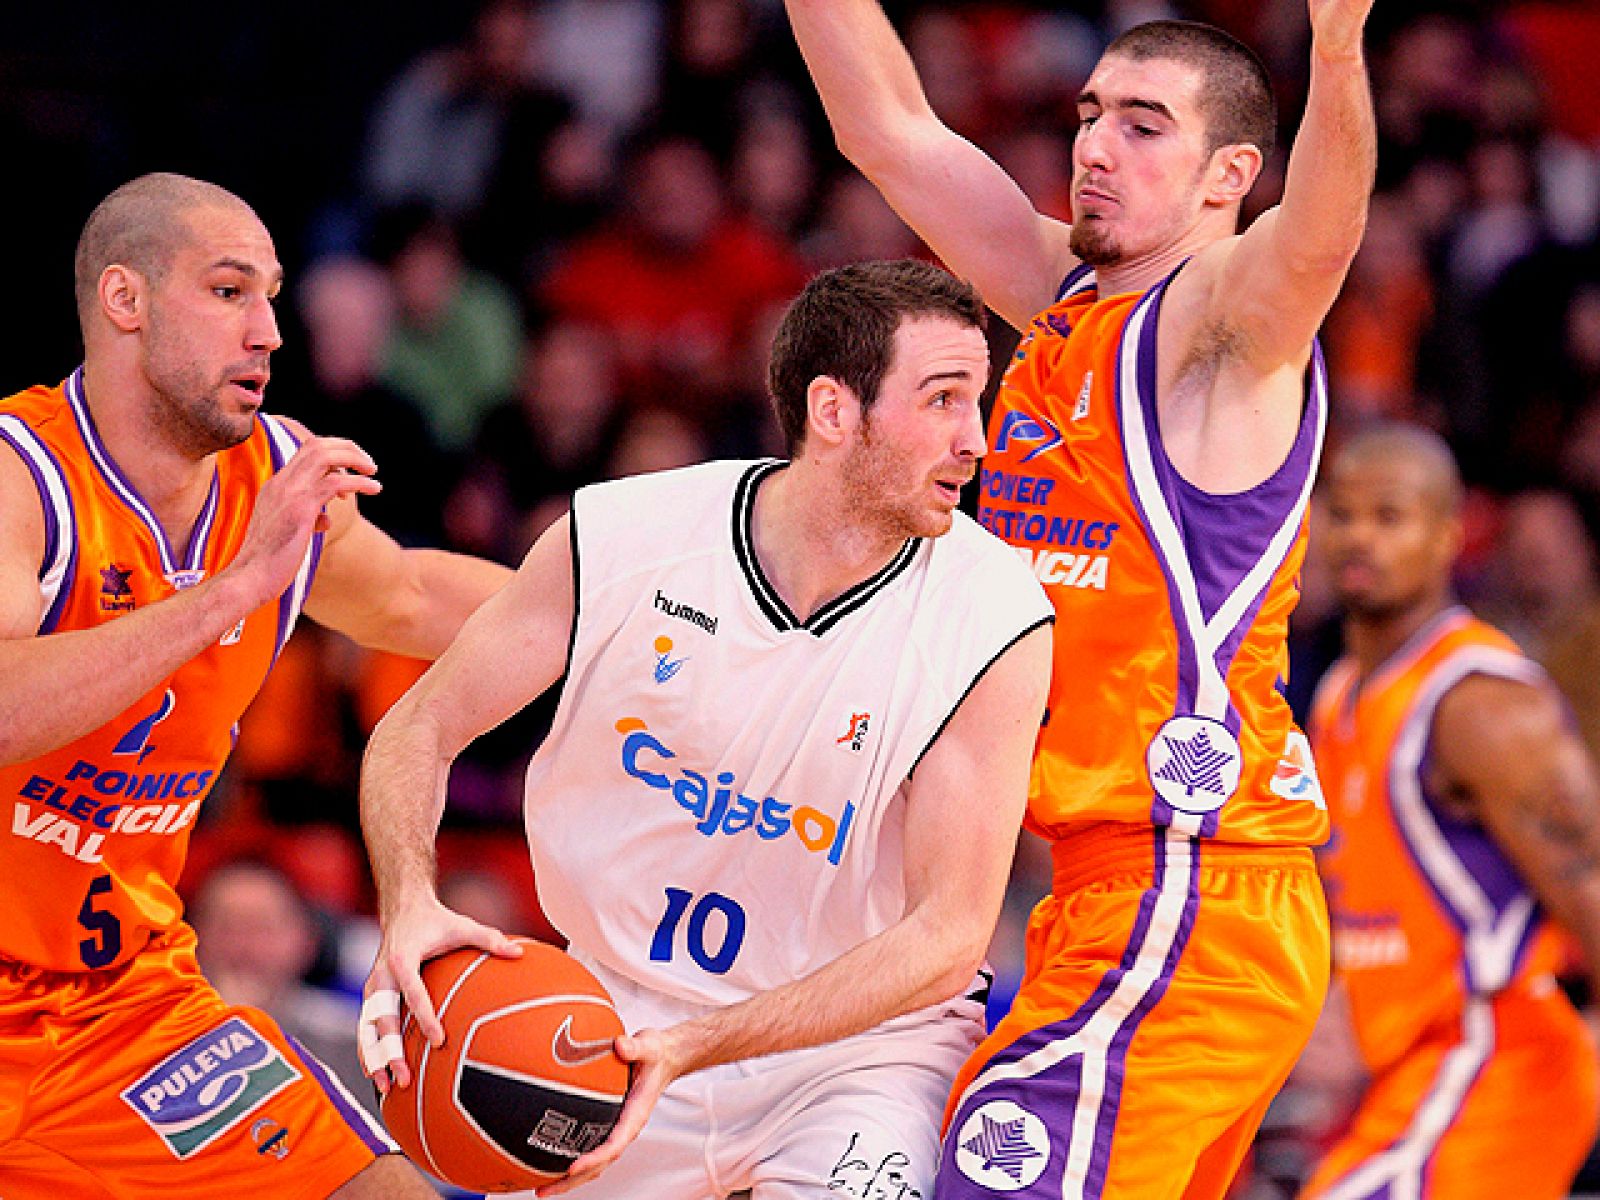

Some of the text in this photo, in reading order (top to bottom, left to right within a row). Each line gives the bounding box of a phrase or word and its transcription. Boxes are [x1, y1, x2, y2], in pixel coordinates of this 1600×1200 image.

[621, 732, 855, 865] Cajasol
[78, 874, 121, 968] 5
[650, 887, 746, 974] 10
[139, 1031, 256, 1112] PULEVA
